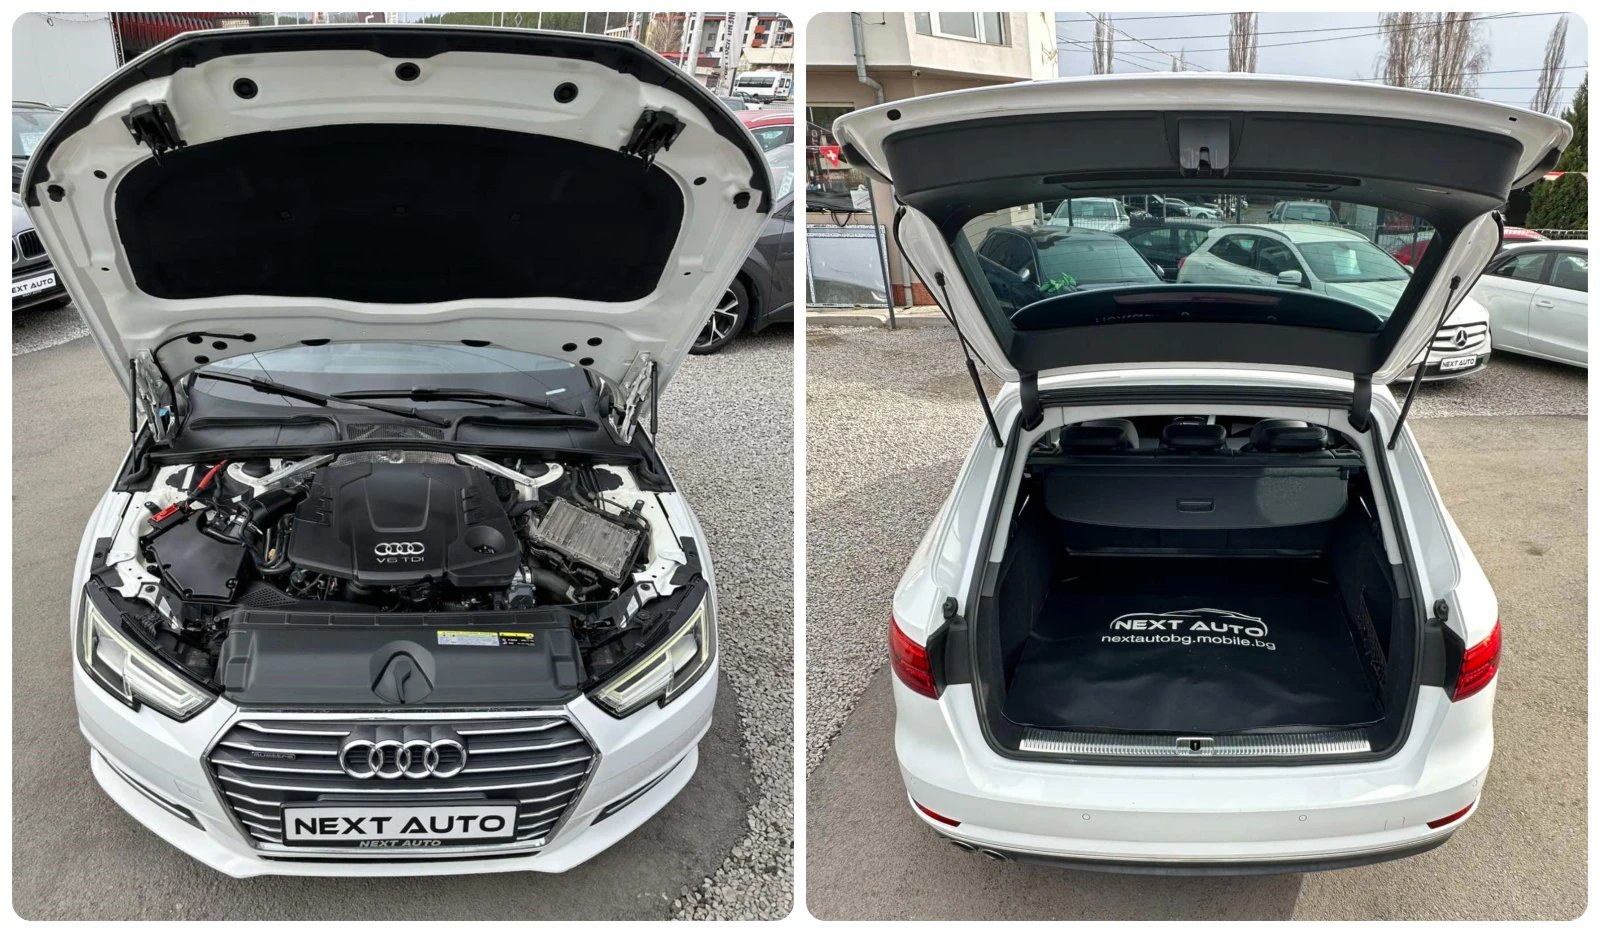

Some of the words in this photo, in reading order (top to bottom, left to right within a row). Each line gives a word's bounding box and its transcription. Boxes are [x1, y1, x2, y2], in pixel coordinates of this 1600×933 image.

[31, 278, 54, 289] AUTO
[1442, 360, 1459, 368] NEXT
[1459, 358, 1475, 366] AUTO
[1114, 619, 1184, 631] NEXT
[1189, 620, 1265, 638] AUTO
[1101, 632, 1277, 651] nextautobg.mobile.bg
[294, 816, 393, 835] NEXT
[399, 815, 506, 834] AUTO
[359, 840, 399, 848] NEXT
[402, 839, 442, 847] AUTO
